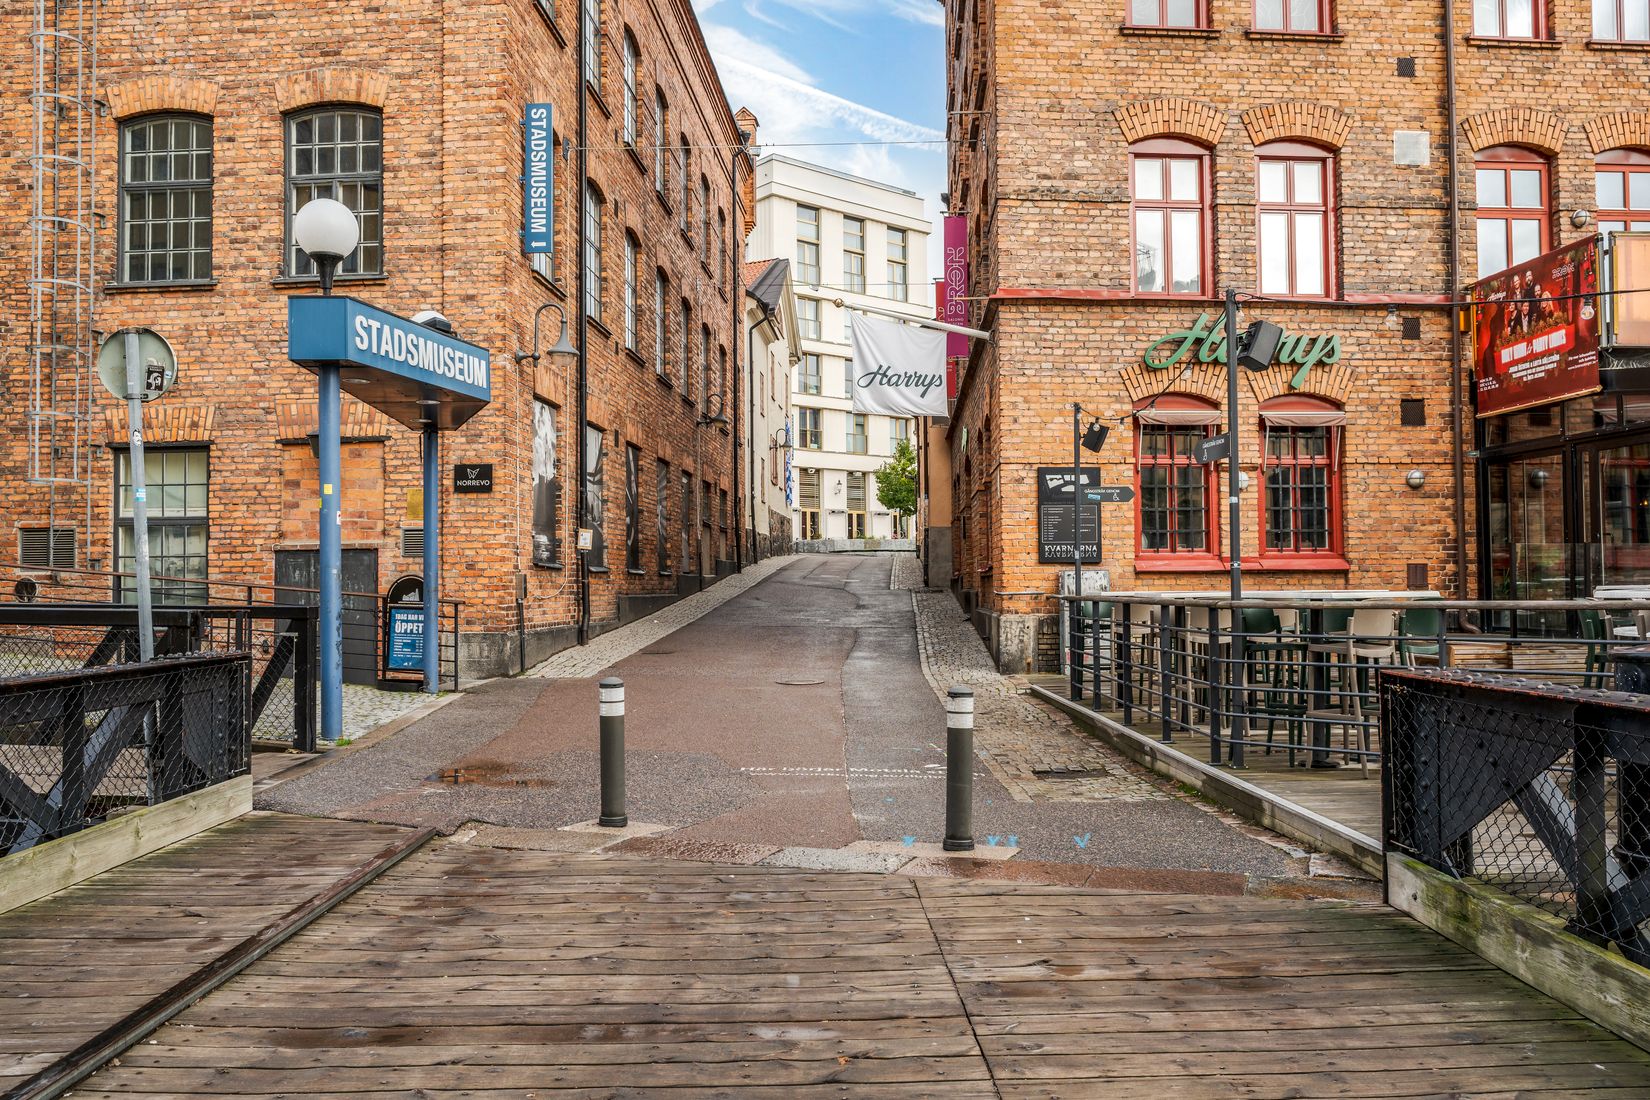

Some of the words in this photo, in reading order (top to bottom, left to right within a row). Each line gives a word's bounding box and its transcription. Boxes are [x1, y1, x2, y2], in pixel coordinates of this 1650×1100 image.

[531, 108, 547, 233] STADSMUSEUM
[355, 315, 487, 388] STADSMUSEUM
[857, 364, 943, 399] Harrys
[456, 479, 490, 487] NORREVO
[394, 620, 424, 633] ÖPPET
